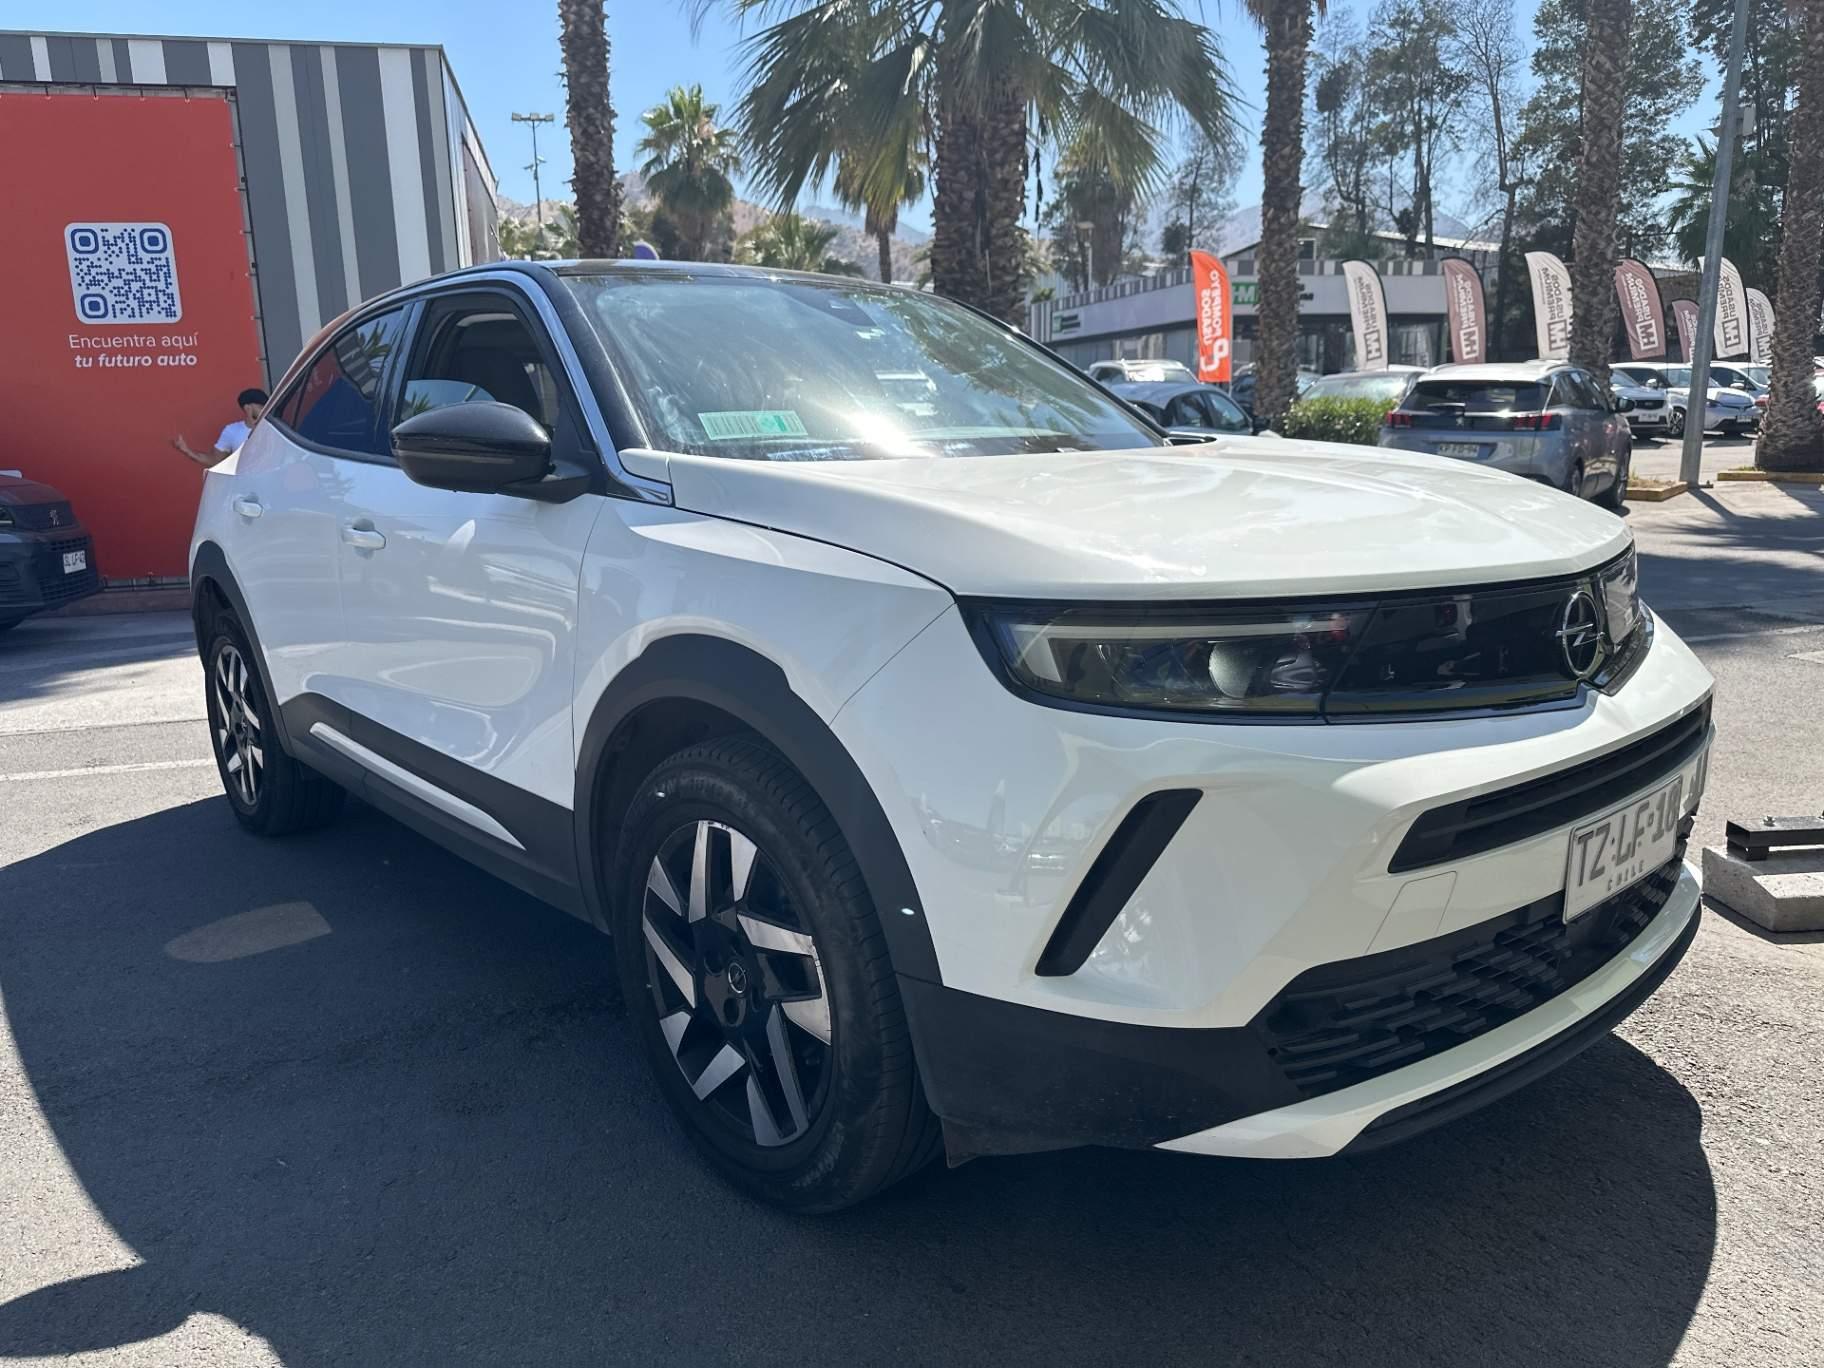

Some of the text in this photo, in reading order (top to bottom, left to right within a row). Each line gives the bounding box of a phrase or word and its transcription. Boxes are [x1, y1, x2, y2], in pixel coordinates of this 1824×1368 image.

[68, 332, 199, 350] Encuentra aquí
[75, 353, 197, 368] tu futuro auto
[1607, 860, 1644, 891] CHILE
